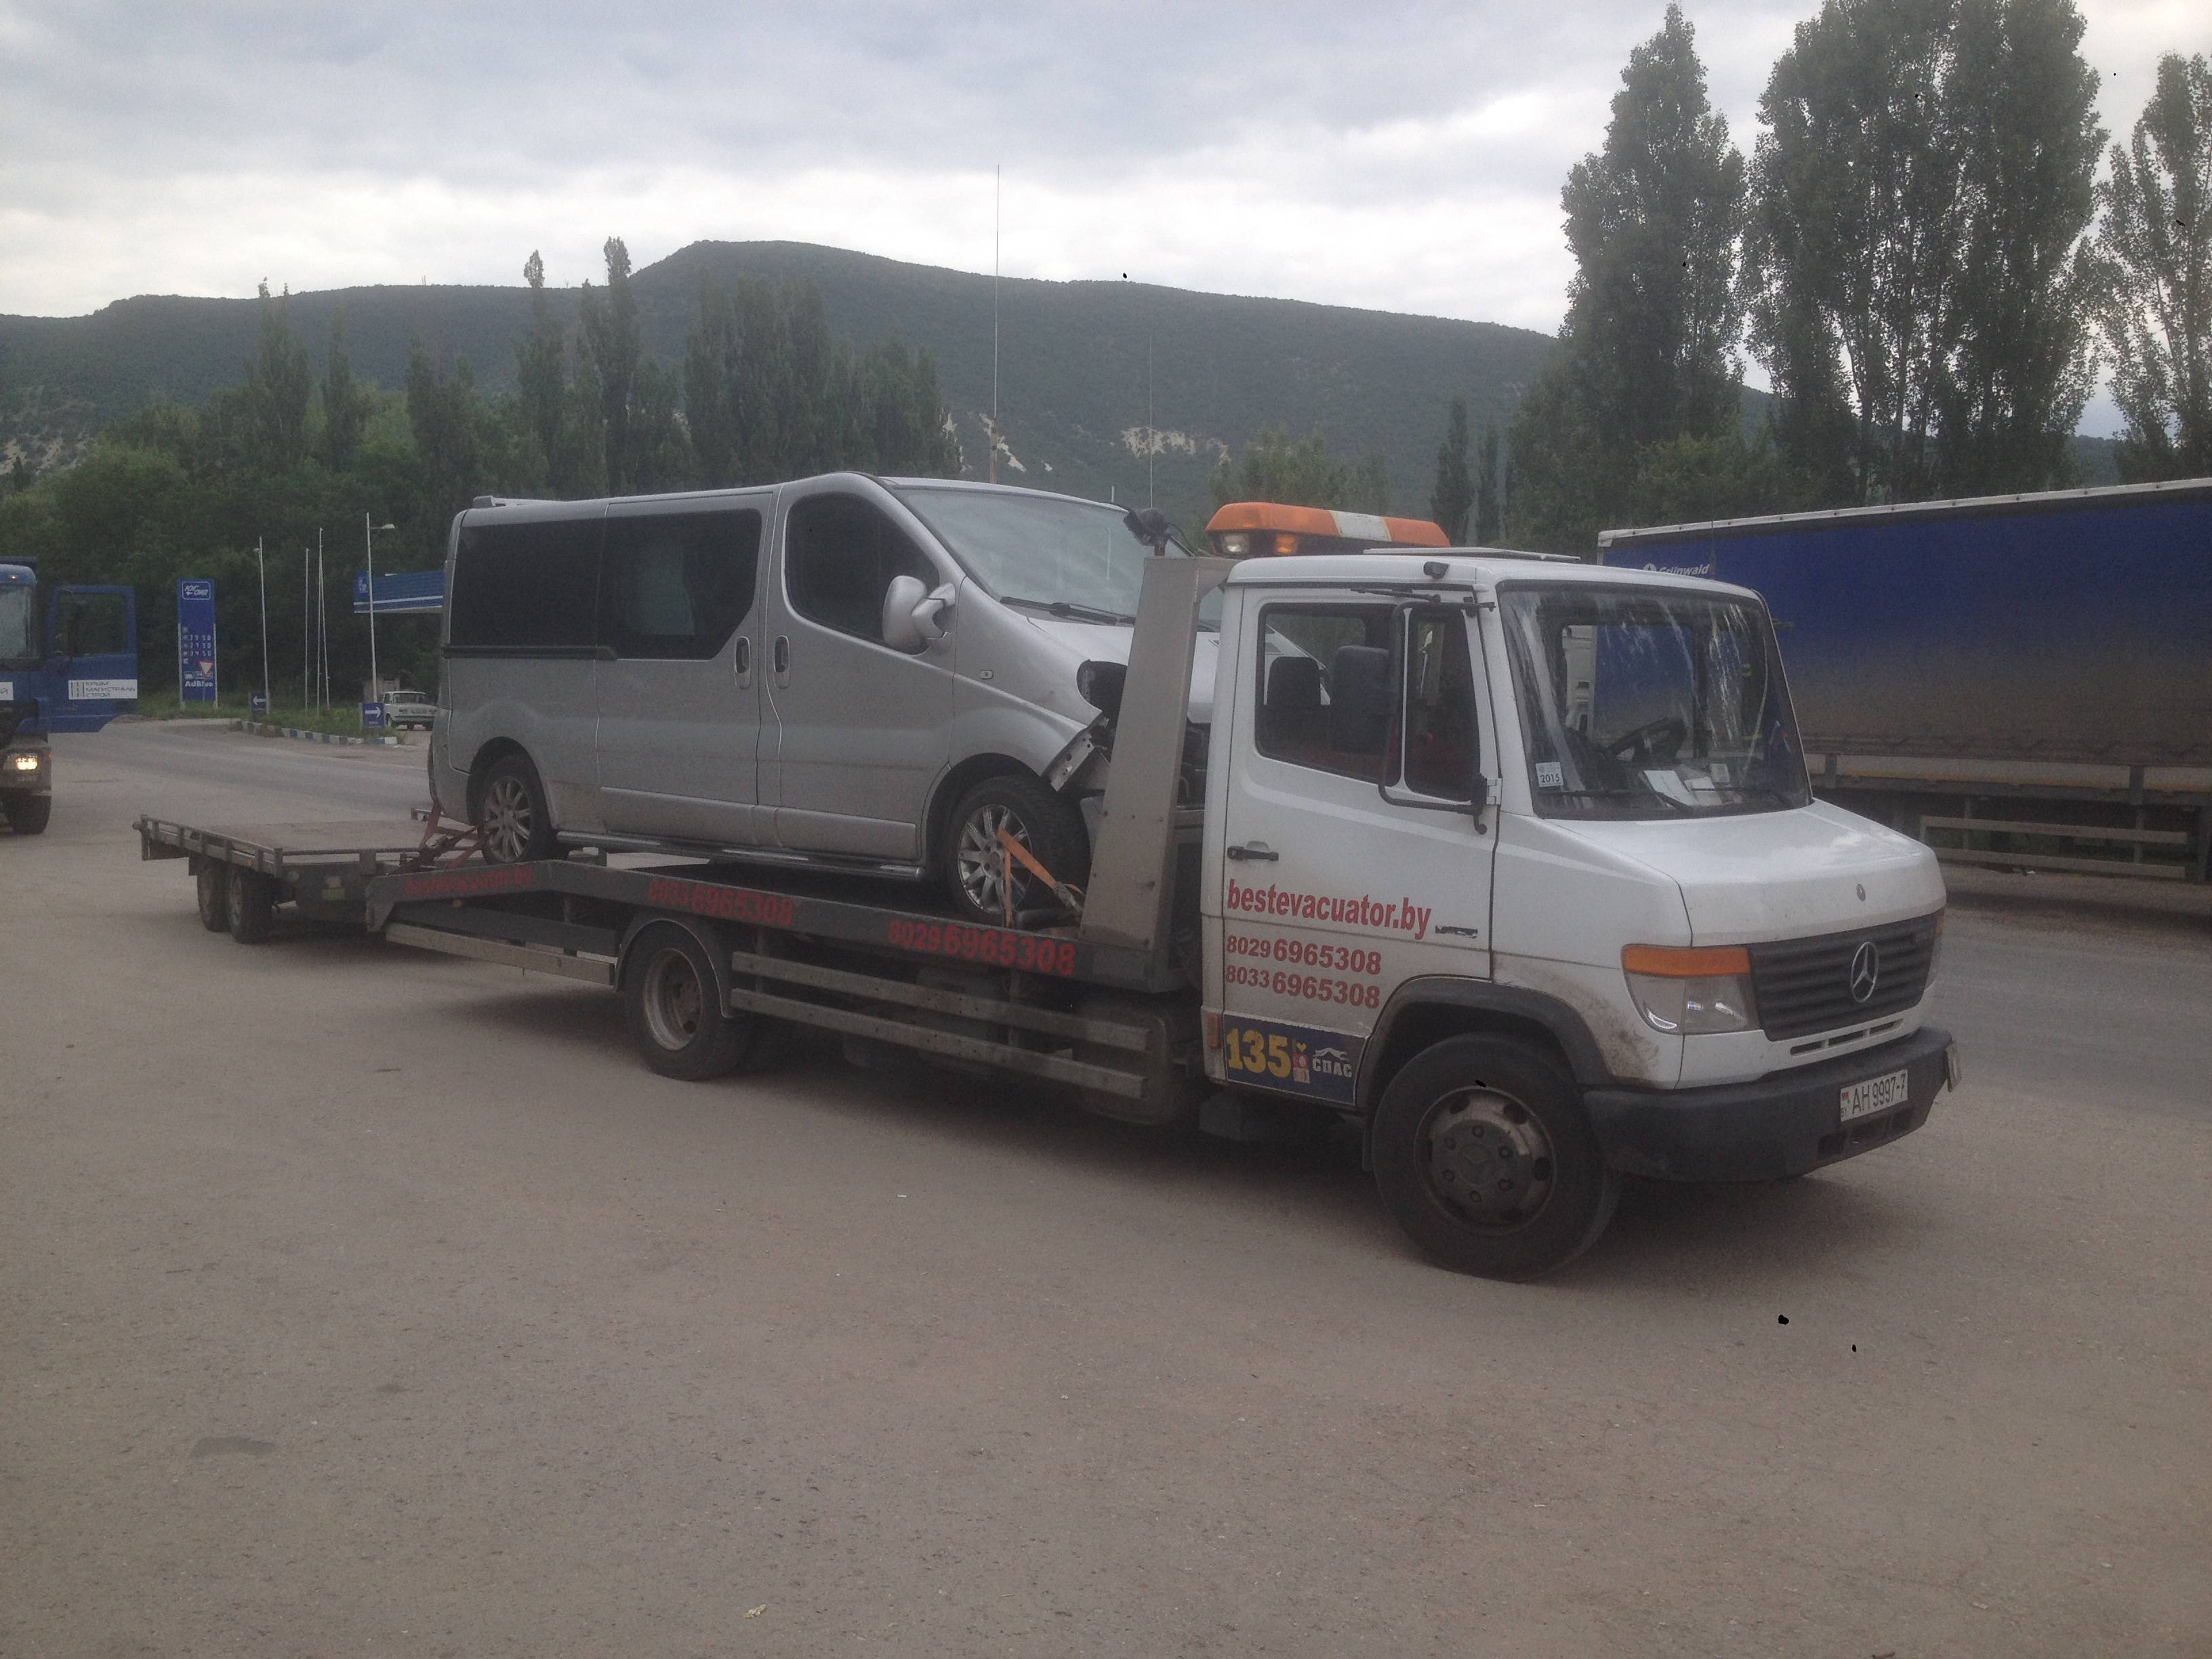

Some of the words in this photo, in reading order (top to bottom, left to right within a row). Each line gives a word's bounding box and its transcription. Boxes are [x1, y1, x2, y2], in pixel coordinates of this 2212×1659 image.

[1540, 773, 1560, 783] 2015
[1227, 878, 1432, 941] bestevacuator.by
[1226, 1028, 1292, 1078] 135
